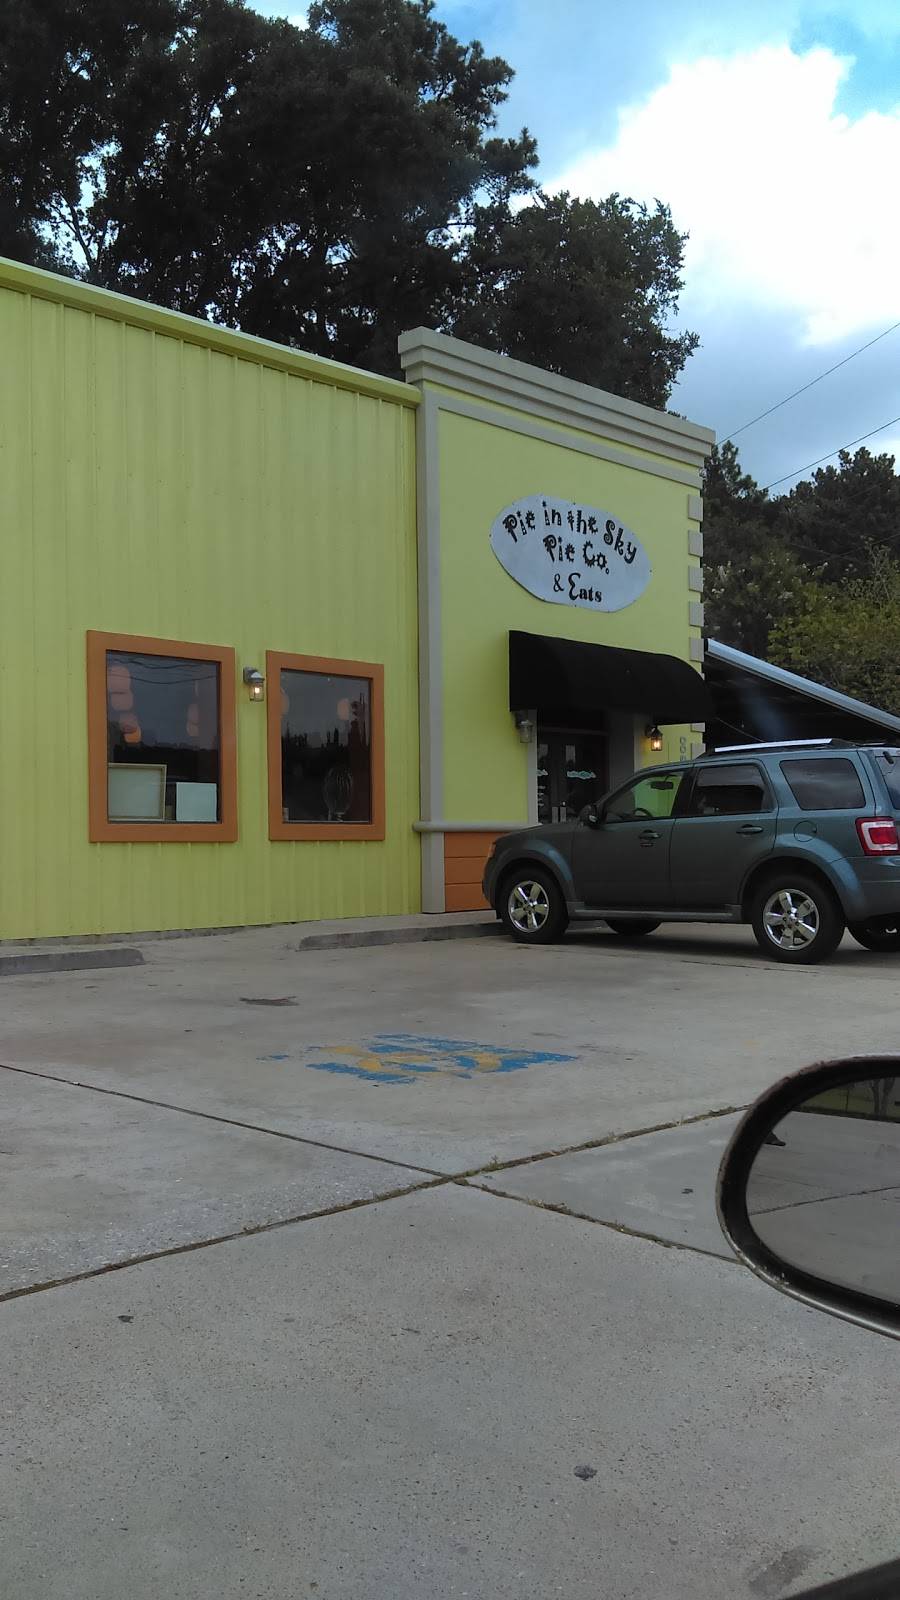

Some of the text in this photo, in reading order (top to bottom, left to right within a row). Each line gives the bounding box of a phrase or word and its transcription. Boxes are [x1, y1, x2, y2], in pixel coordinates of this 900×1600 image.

[502, 510, 536, 544] Pie
[567, 510, 598, 535] the
[603, 519, 637, 564] Sky
[543, 534, 610, 575] Pie Co.
[553, 572, 602, 602] & Eats
